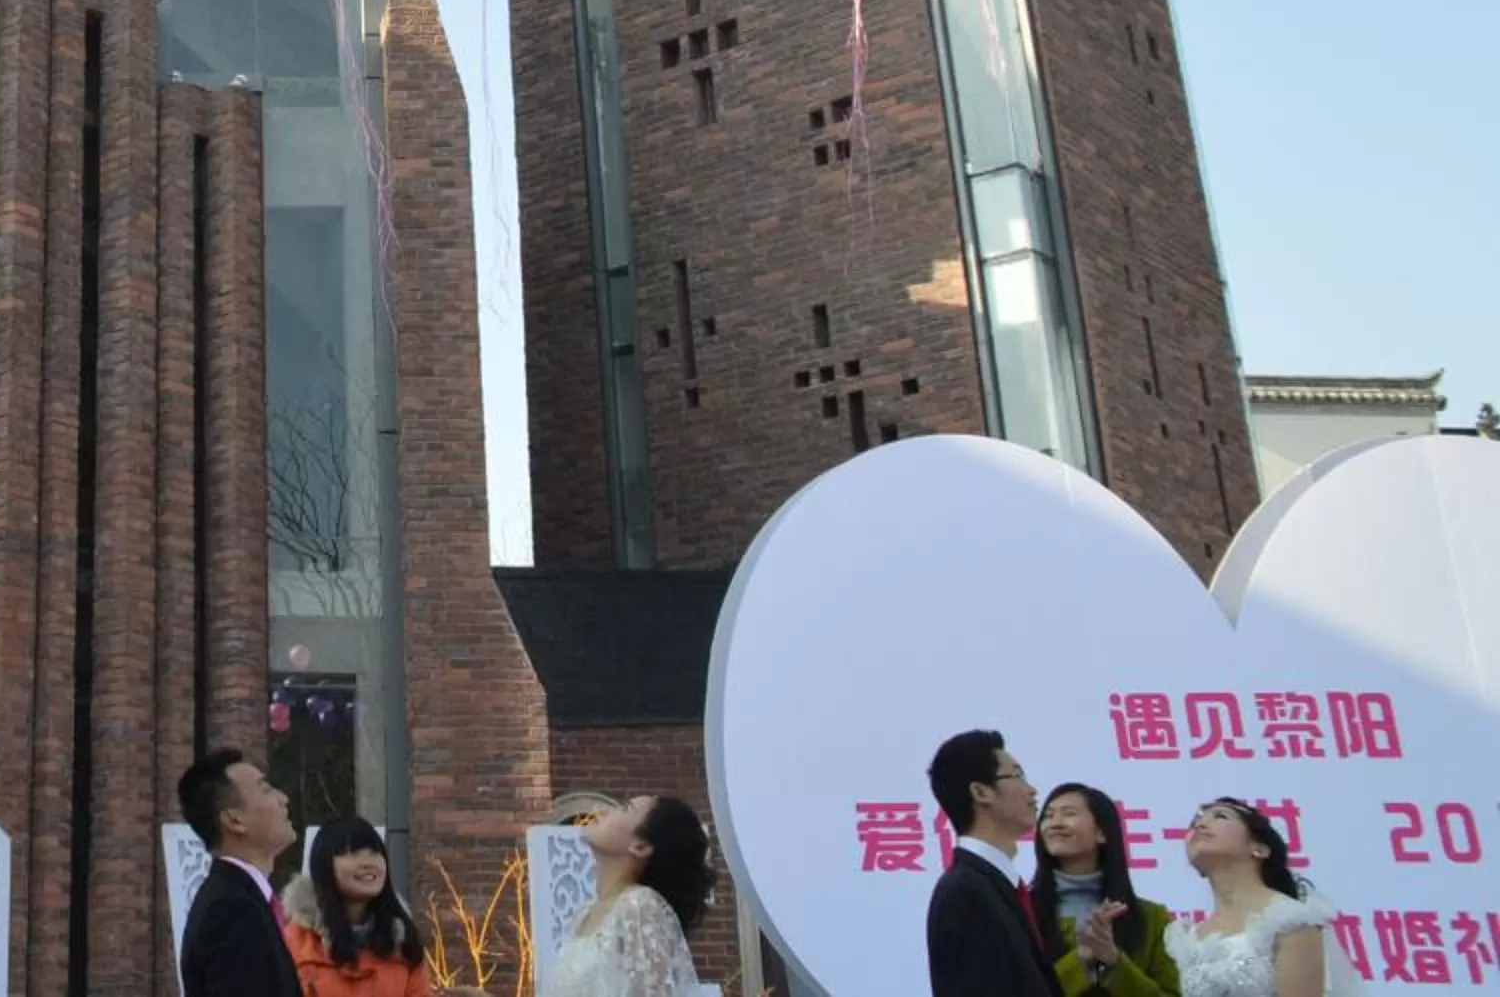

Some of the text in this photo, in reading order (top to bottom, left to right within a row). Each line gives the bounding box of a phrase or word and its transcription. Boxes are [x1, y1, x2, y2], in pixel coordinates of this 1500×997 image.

[1108, 691, 1404, 760] 遇见黎阳
[1383, 802, 1500, 864] 20
